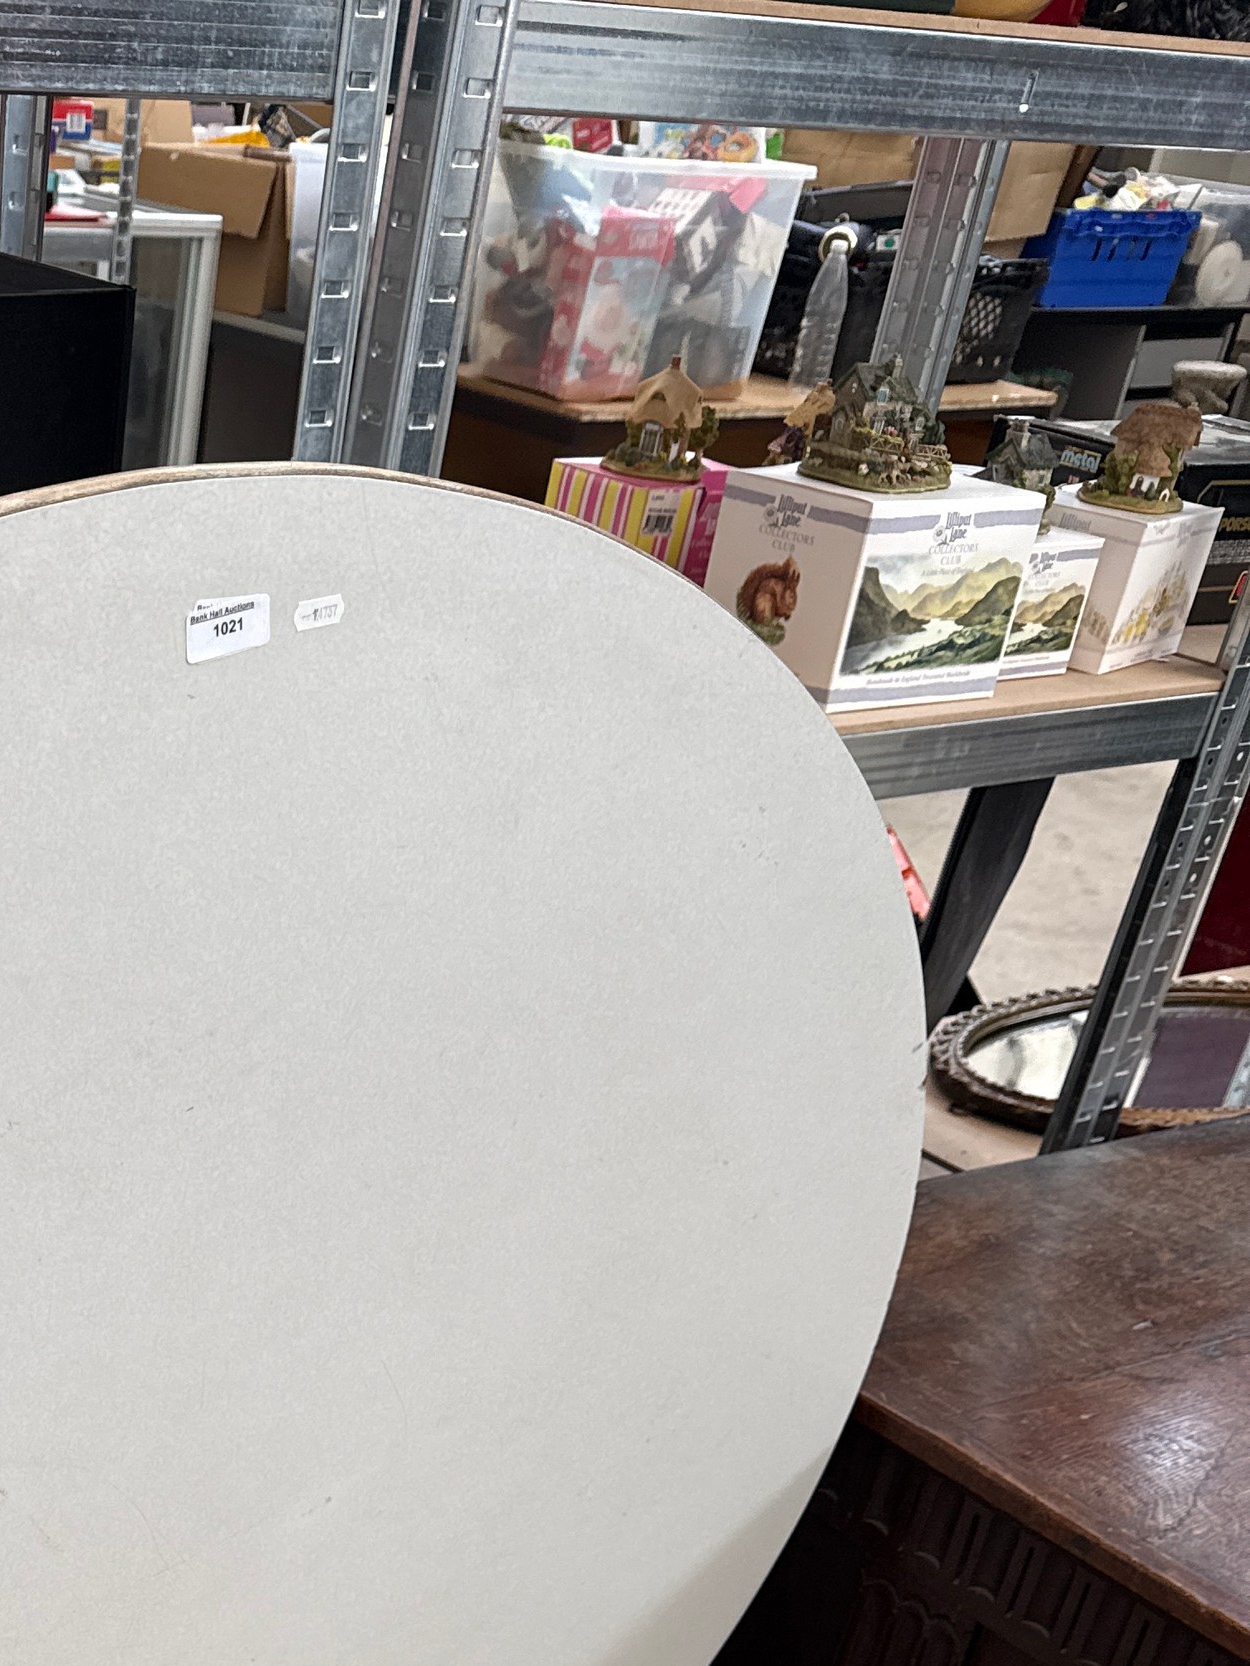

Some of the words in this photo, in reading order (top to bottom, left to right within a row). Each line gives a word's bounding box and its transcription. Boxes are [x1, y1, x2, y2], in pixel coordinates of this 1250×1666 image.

[1060, 450, 1102, 473] metal
[777, 494, 808, 515] Lilliput
[780, 511, 801, 528] Lane
[945, 511, 972, 529] Lilliput
[759, 524, 815, 546] COLLECTORS
[949, 527, 968, 543] Lane
[772, 539, 796, 553] CLUB
[928, 543, 979, 555] COLLECTORS
[940, 555, 962, 566] CLUB
[190, 612, 208, 625] Bank
[209, 608, 223, 620] Hall
[224, 601, 255, 616] Auctions
[213, 616, 243, 638] 1021
